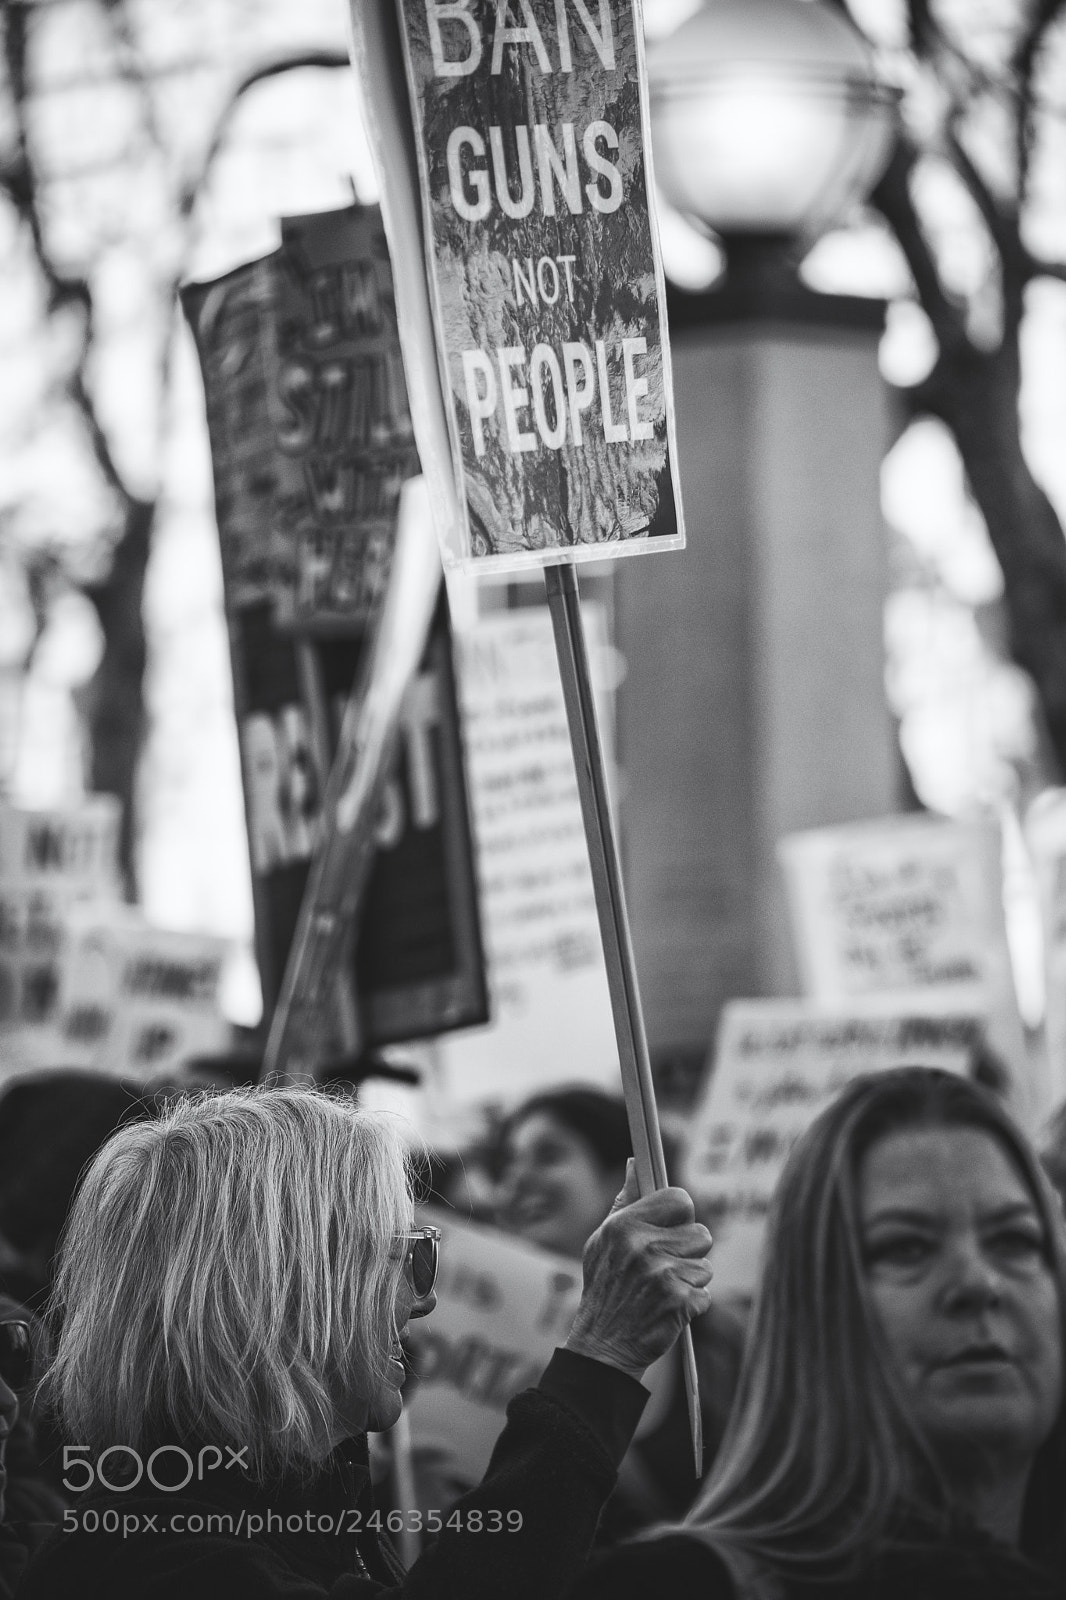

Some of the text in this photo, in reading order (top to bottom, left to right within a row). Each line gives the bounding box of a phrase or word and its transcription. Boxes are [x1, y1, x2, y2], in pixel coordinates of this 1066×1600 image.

[424, 0, 616, 77] BAN
[445, 120, 624, 221] GUNS
[510, 255, 577, 305] NOT
[462, 336, 655, 456] PEOPLE
